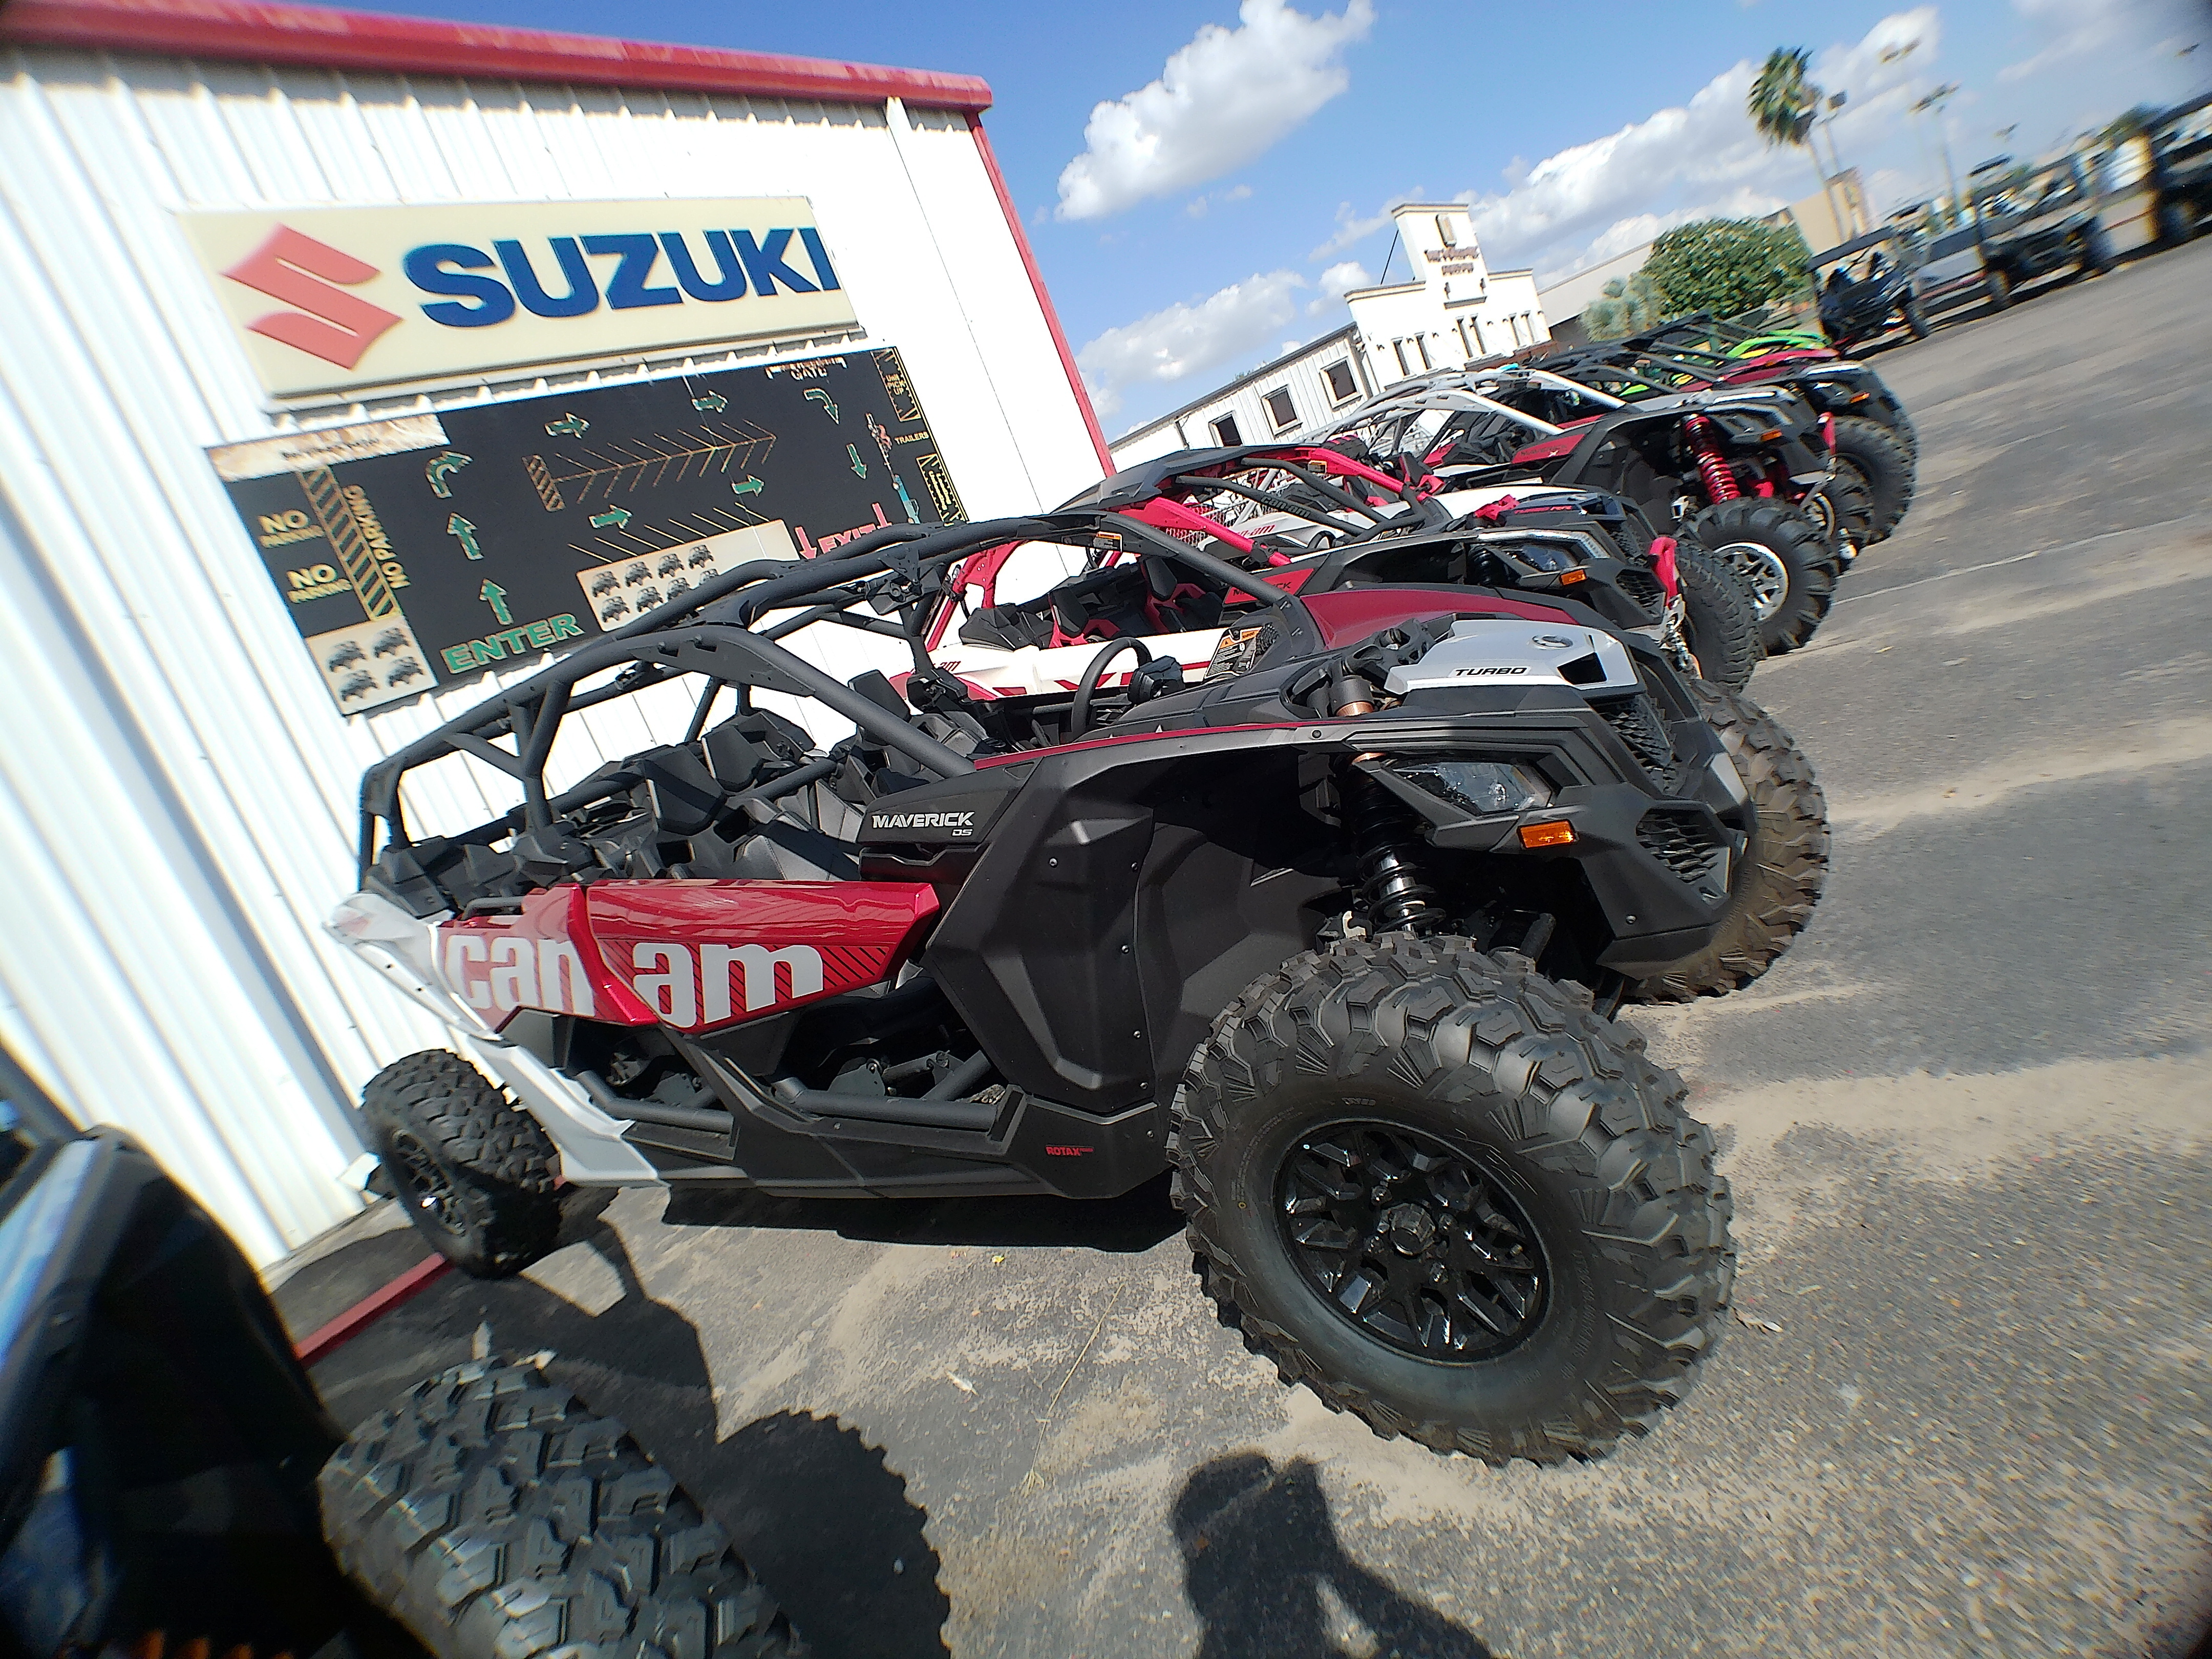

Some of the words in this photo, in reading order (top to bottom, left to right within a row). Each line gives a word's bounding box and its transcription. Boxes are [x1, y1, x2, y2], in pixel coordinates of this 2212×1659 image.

[402, 227, 841, 328] SUZUKI
[887, 380, 906, 389] PICK
[893, 387, 904, 395] UP
[894, 431, 929, 445] TRAILERS
[1261, 495, 1315, 518] can-am
[257, 509, 309, 534] NO
[343, 484, 397, 561] PARKING
[1238, 525, 1275, 536] n-am
[286, 563, 338, 589] NO
[381, 561, 411, 589] NO
[440, 612, 586, 674] ENTER
[1456, 667, 1527, 676] TURBO
[872, 812, 975, 828] MAVERICK
[633, 942, 823, 1028] am
[1046, 1146, 1081, 1156] ROTAX
